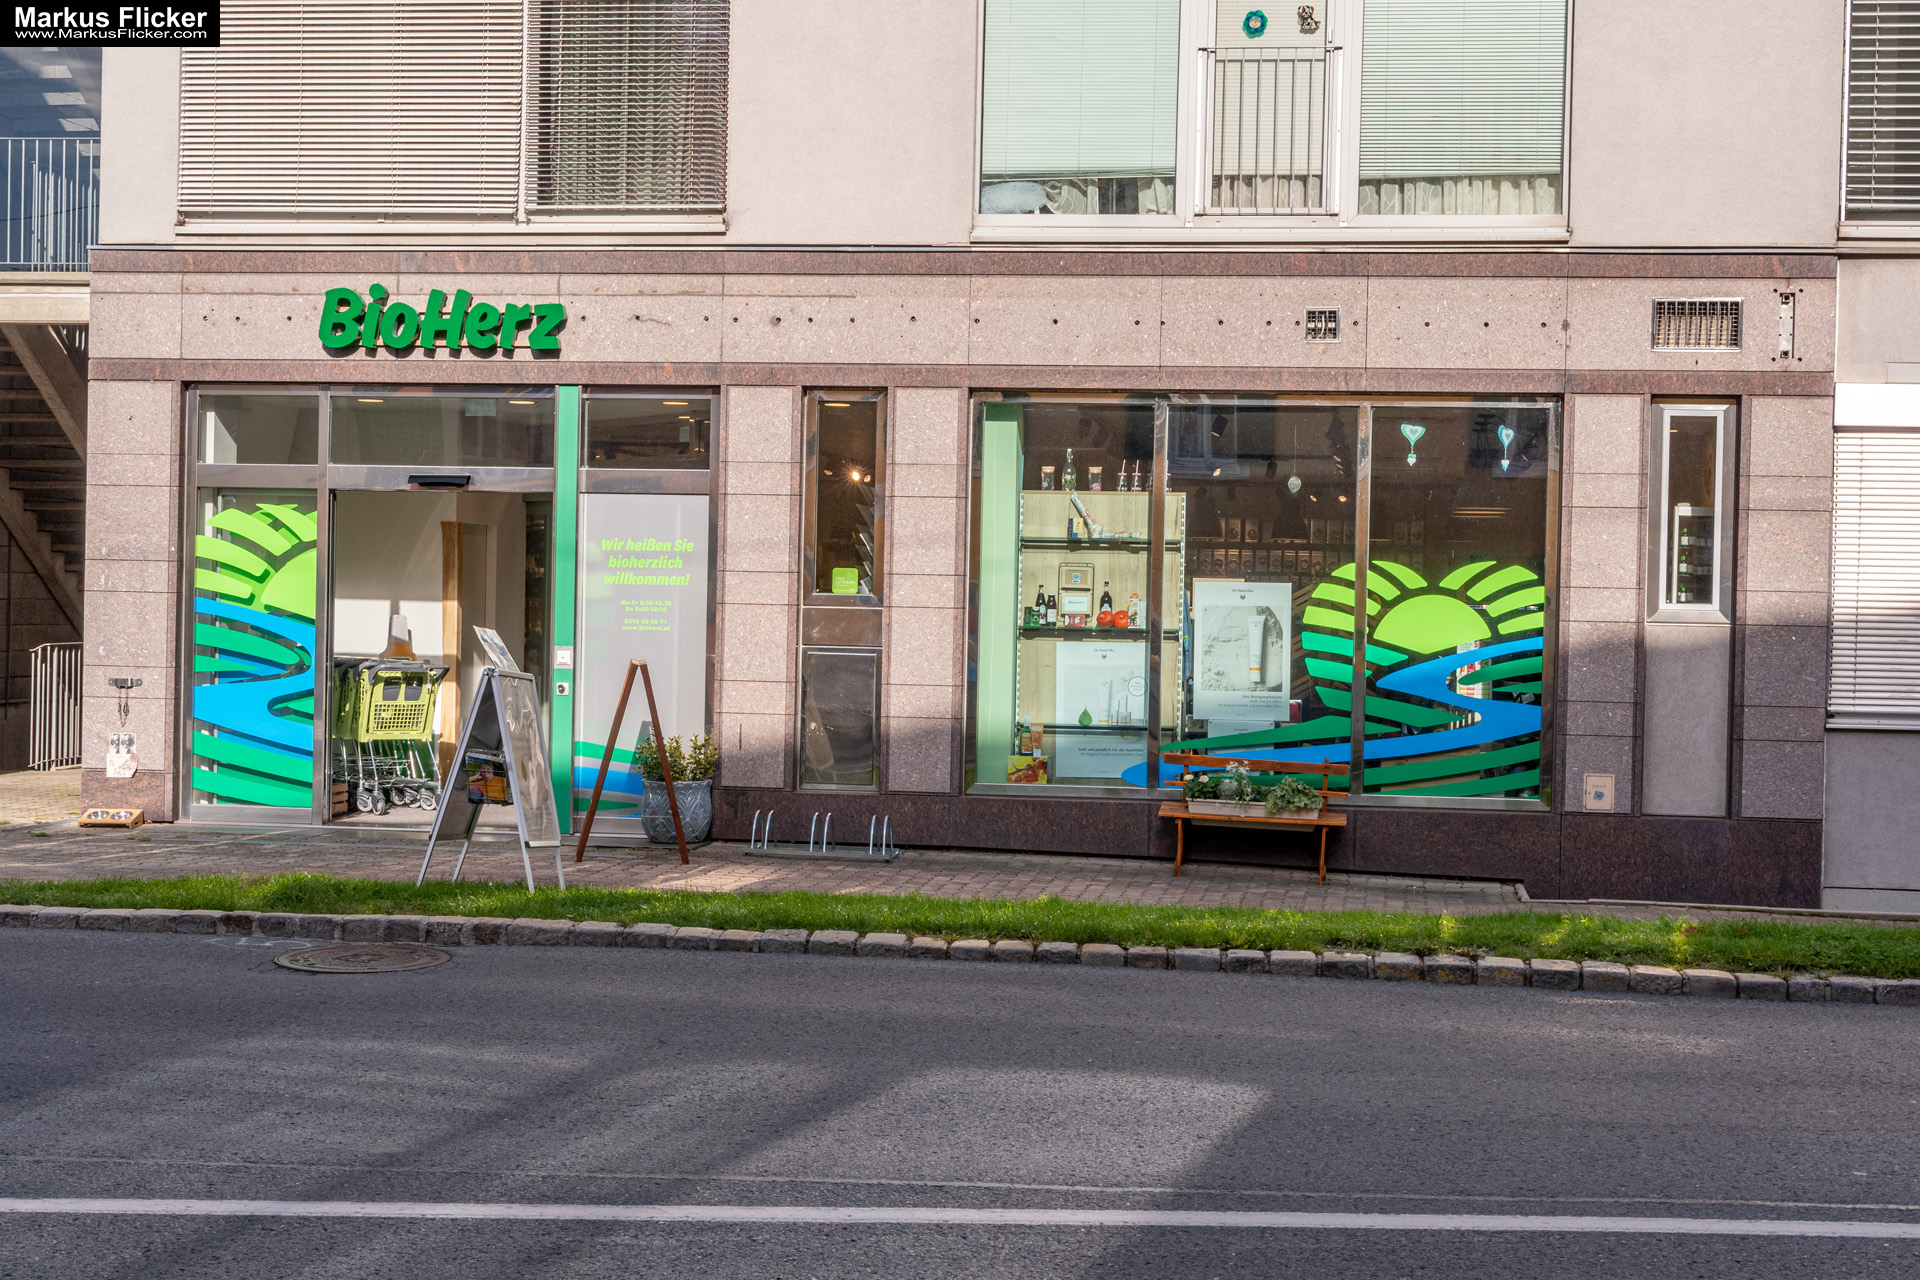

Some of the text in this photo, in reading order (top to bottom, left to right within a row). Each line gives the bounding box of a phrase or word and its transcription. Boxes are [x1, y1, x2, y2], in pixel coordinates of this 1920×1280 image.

[318, 283, 566, 351] BioHerz
[601, 537, 695, 552] Wir heißen Sie
[608, 555, 683, 568] bioherzlich
[604, 571, 691, 586] willkommen!
